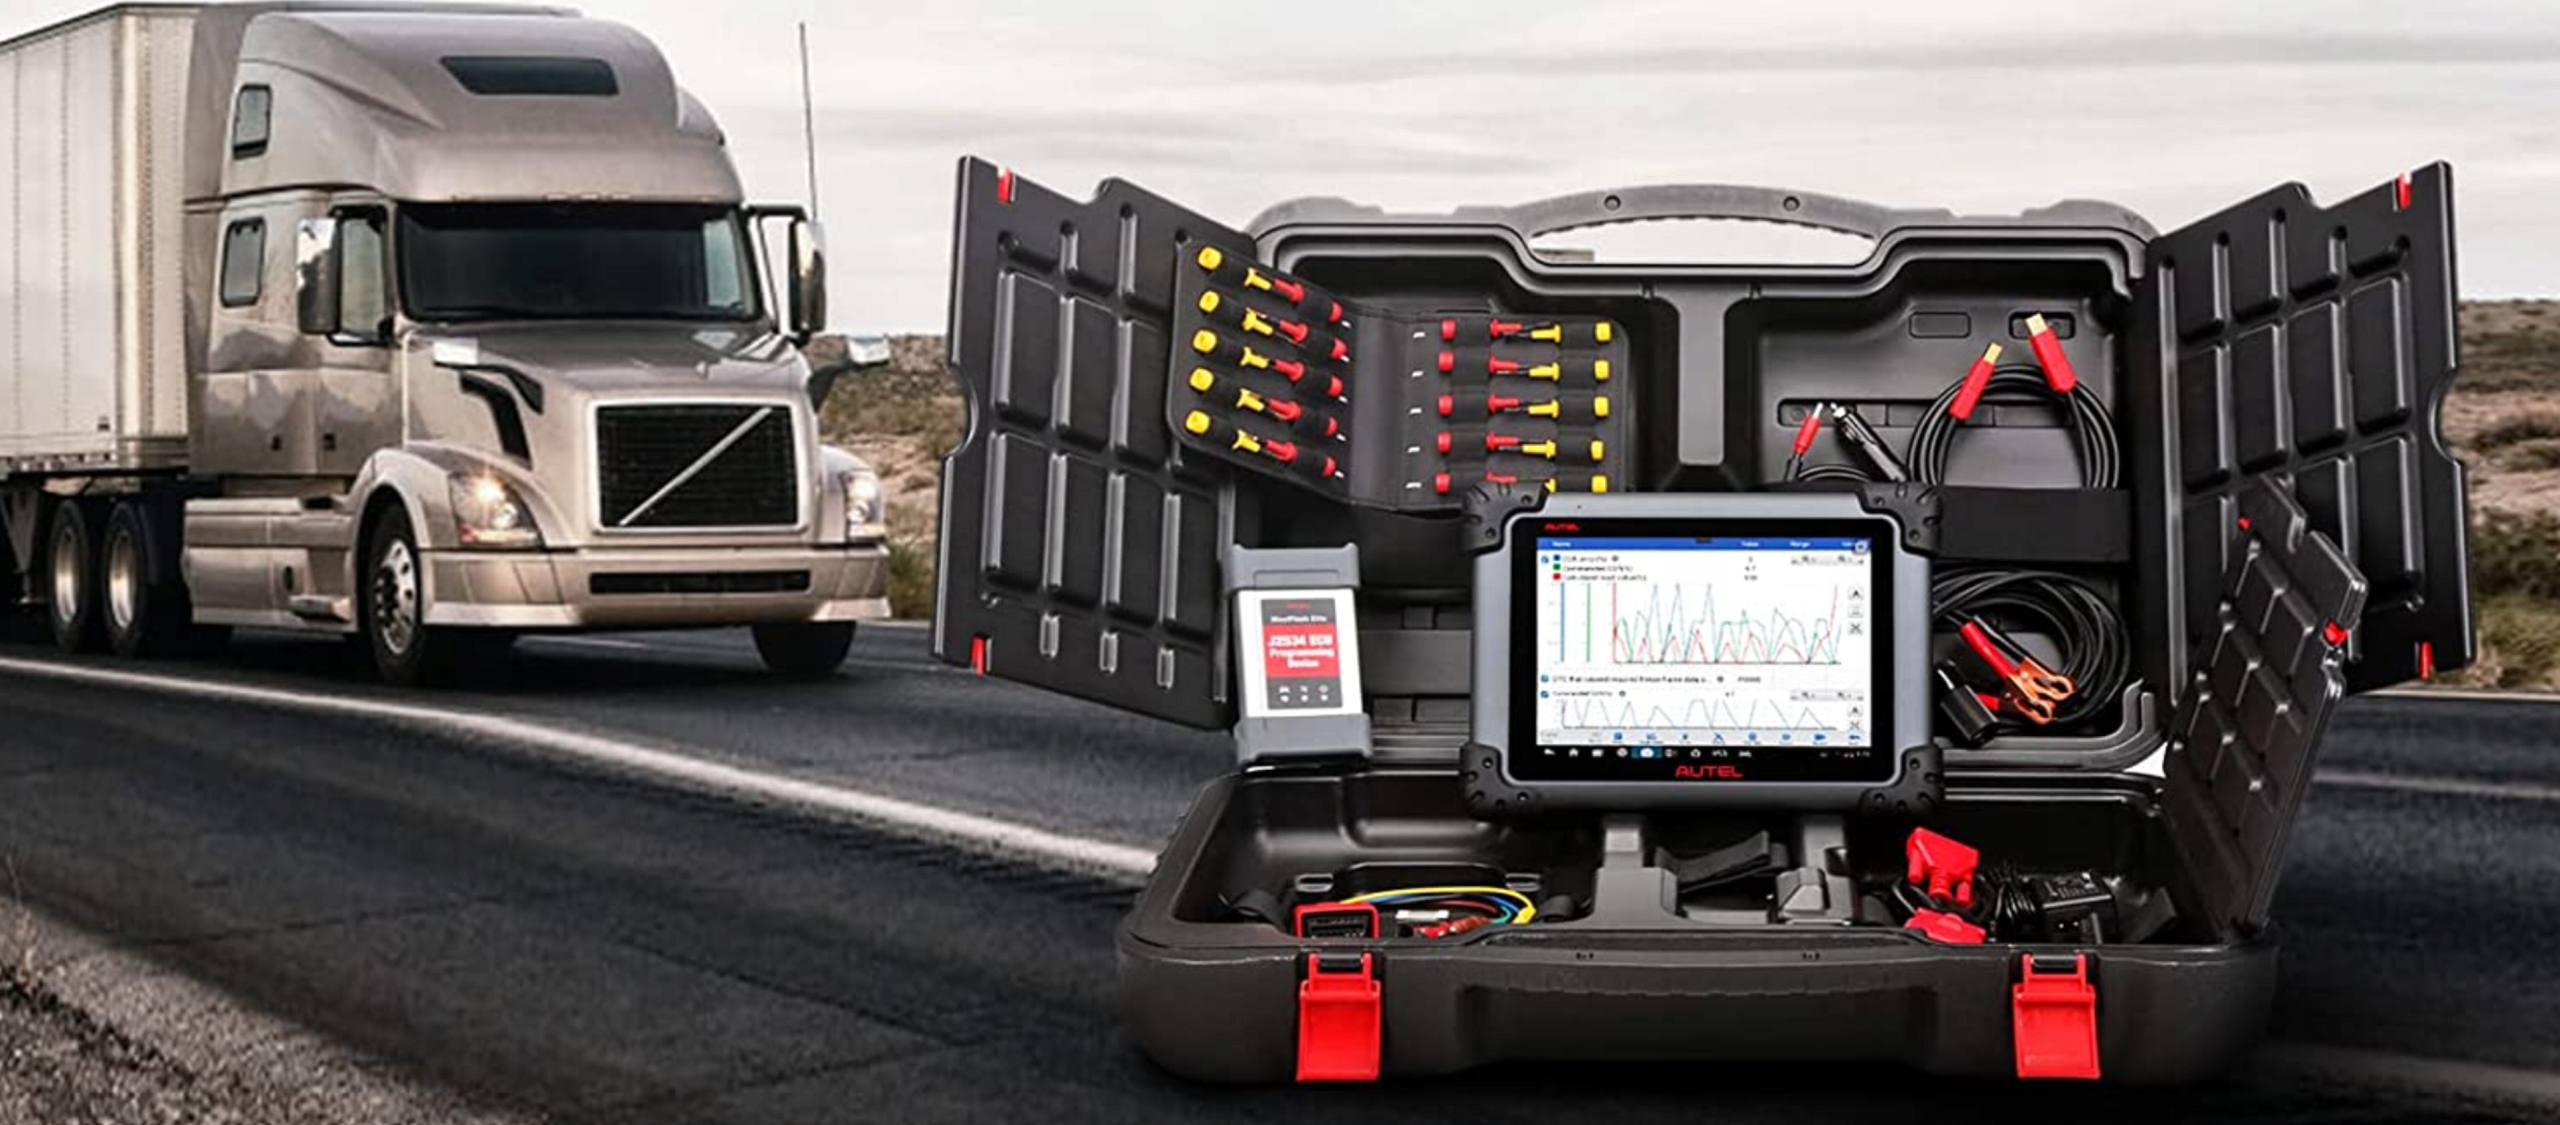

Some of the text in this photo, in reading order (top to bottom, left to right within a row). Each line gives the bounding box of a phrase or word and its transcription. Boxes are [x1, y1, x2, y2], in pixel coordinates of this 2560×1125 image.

[1268, 633, 1333, 647] J2534 ECU
[1269, 648, 1334, 660] Programming
[1287, 659, 1319, 668] Device
[1674, 765, 1744, 779] AUTEL
